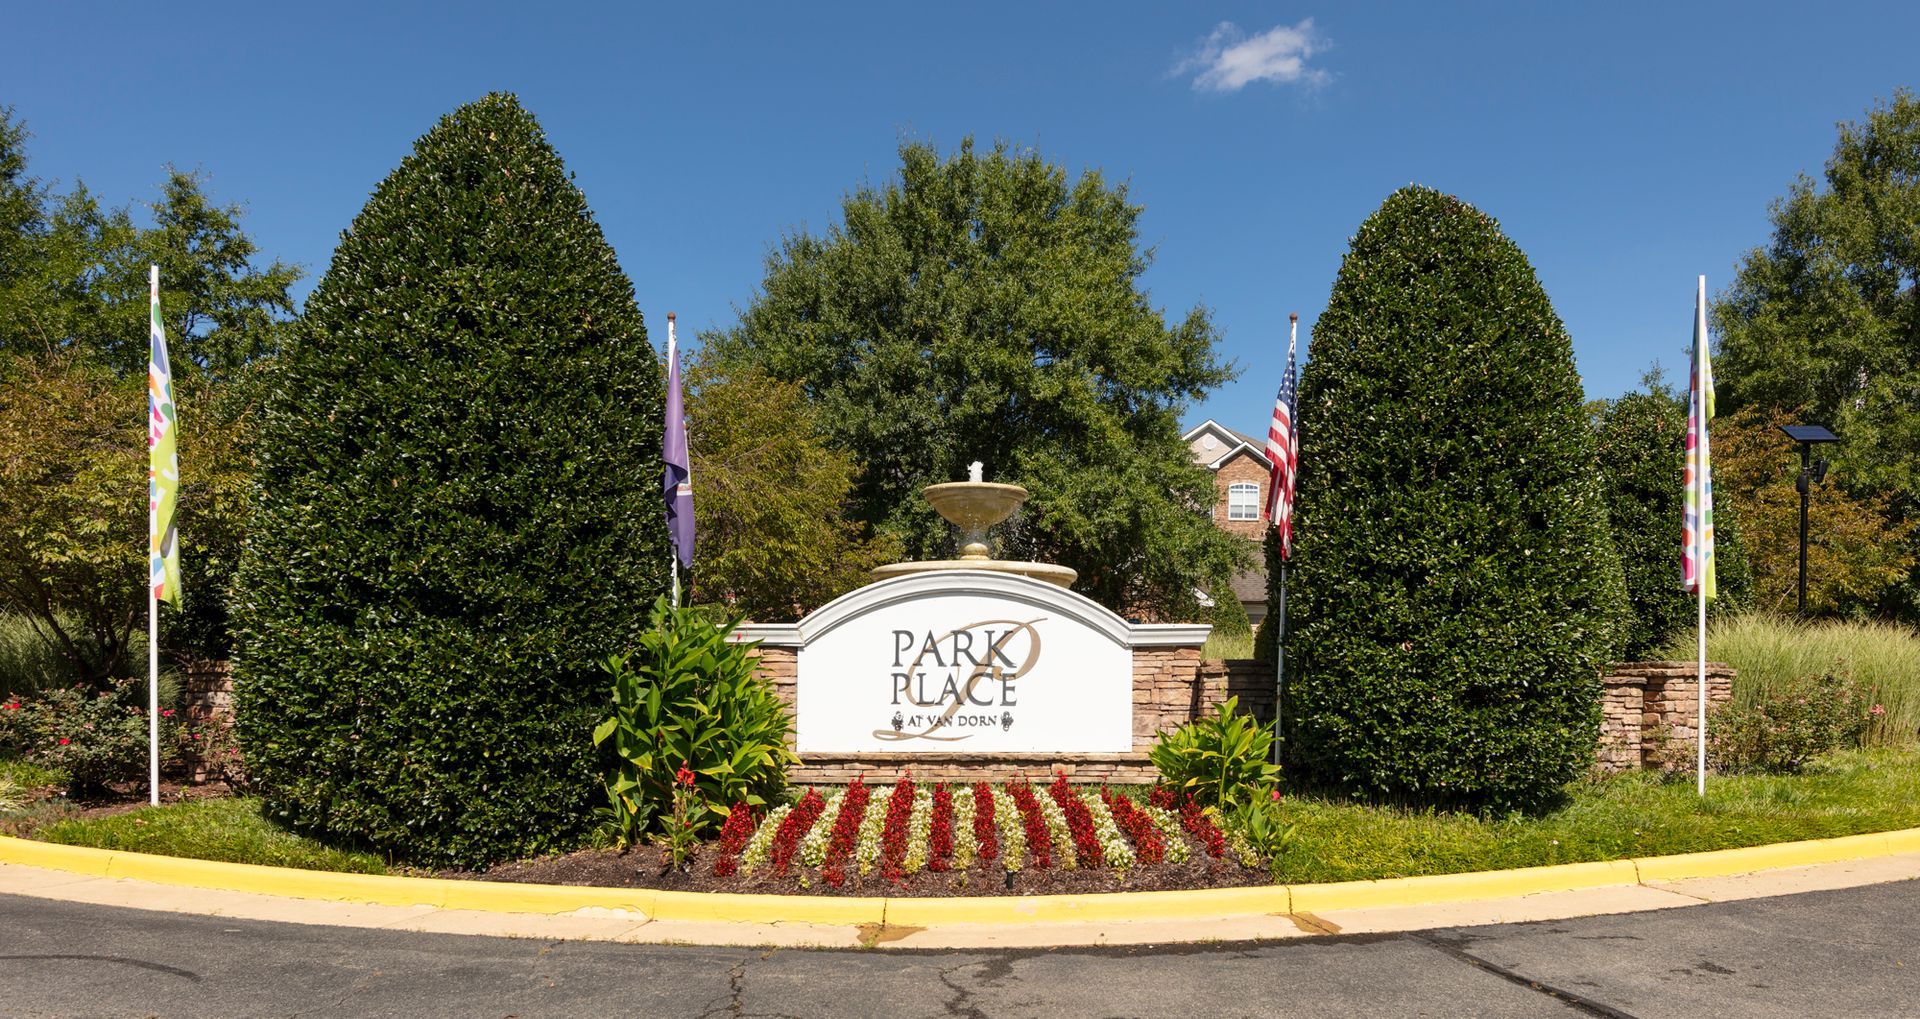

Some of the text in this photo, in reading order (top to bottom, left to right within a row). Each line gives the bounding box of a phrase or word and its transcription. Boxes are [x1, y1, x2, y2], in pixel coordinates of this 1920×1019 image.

[891, 629, 1017, 668] PARK
[890, 672, 1017, 707] PLACE
[907, 714, 998, 728] AT VAN DORN
